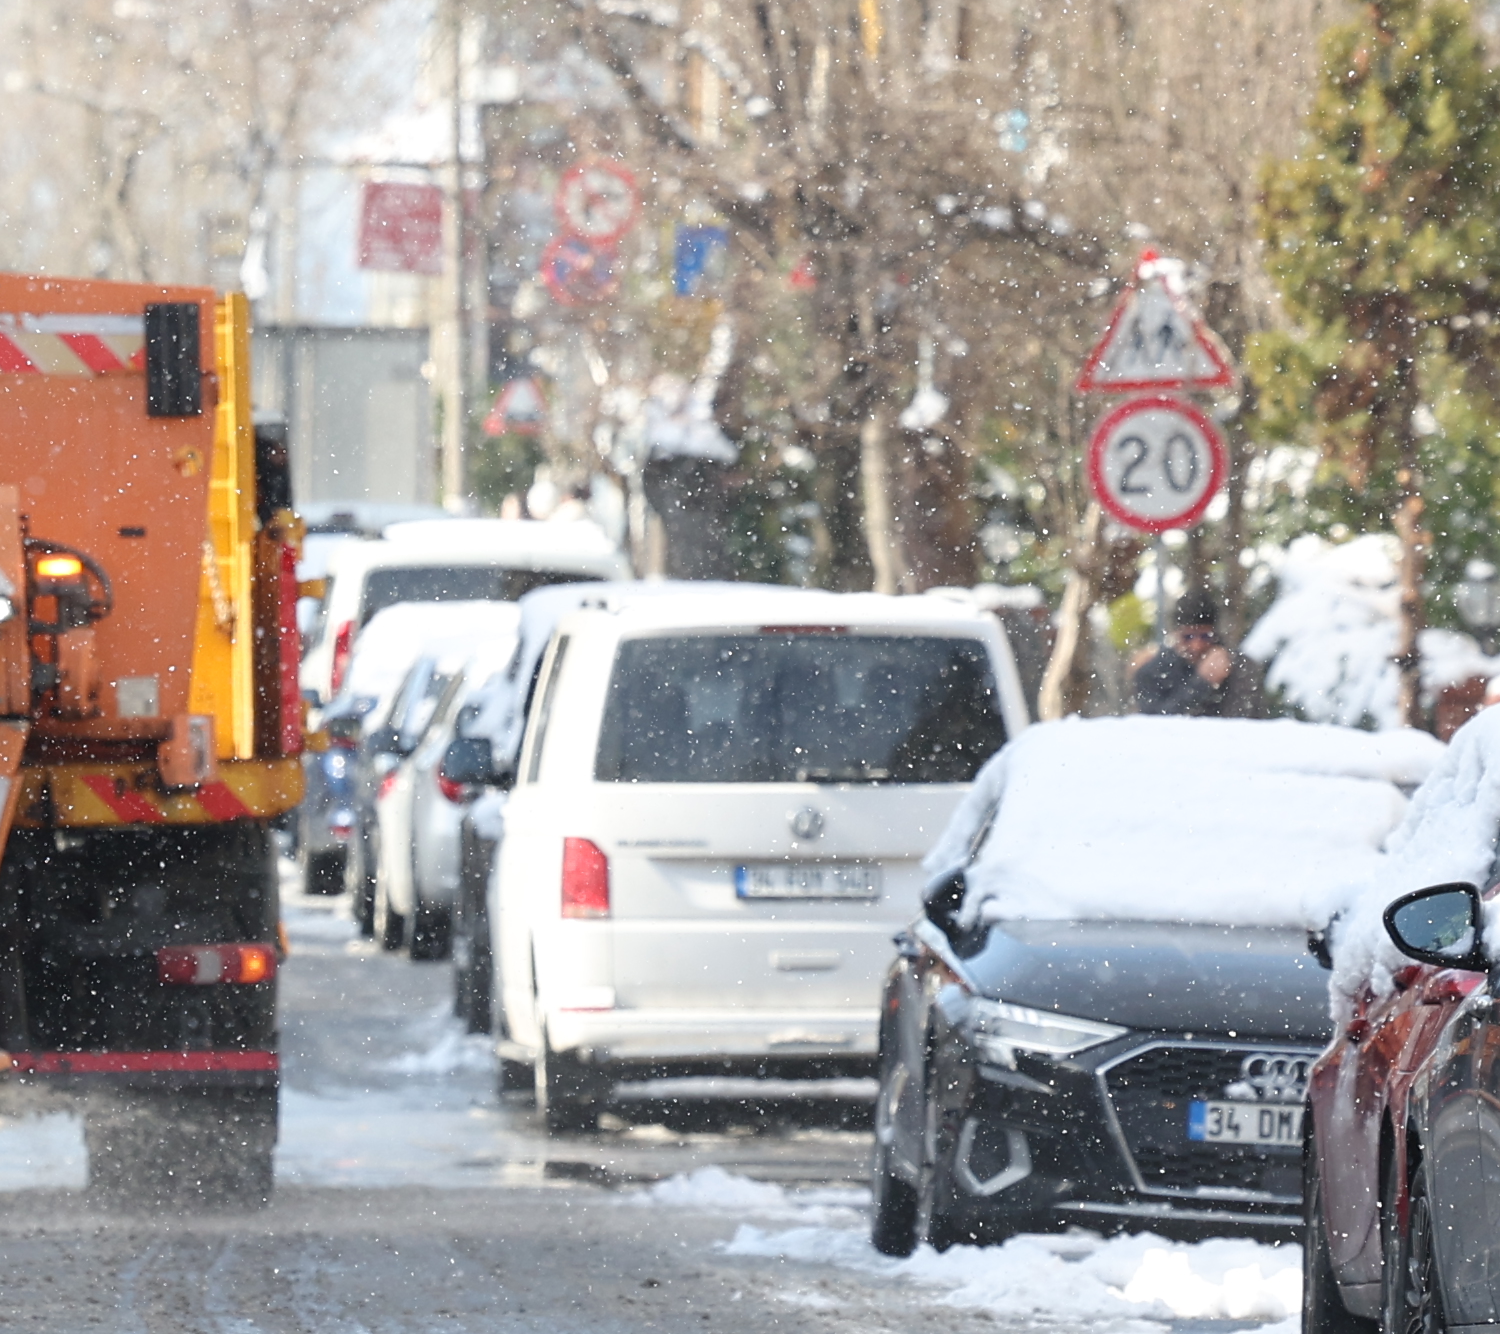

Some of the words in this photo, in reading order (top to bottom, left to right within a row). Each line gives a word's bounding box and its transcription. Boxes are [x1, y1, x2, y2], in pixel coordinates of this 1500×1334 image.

[1116, 433, 1199, 494] 20
[1208, 1107, 1239, 1138] 34
[1258, 1108, 1305, 1141] DM
